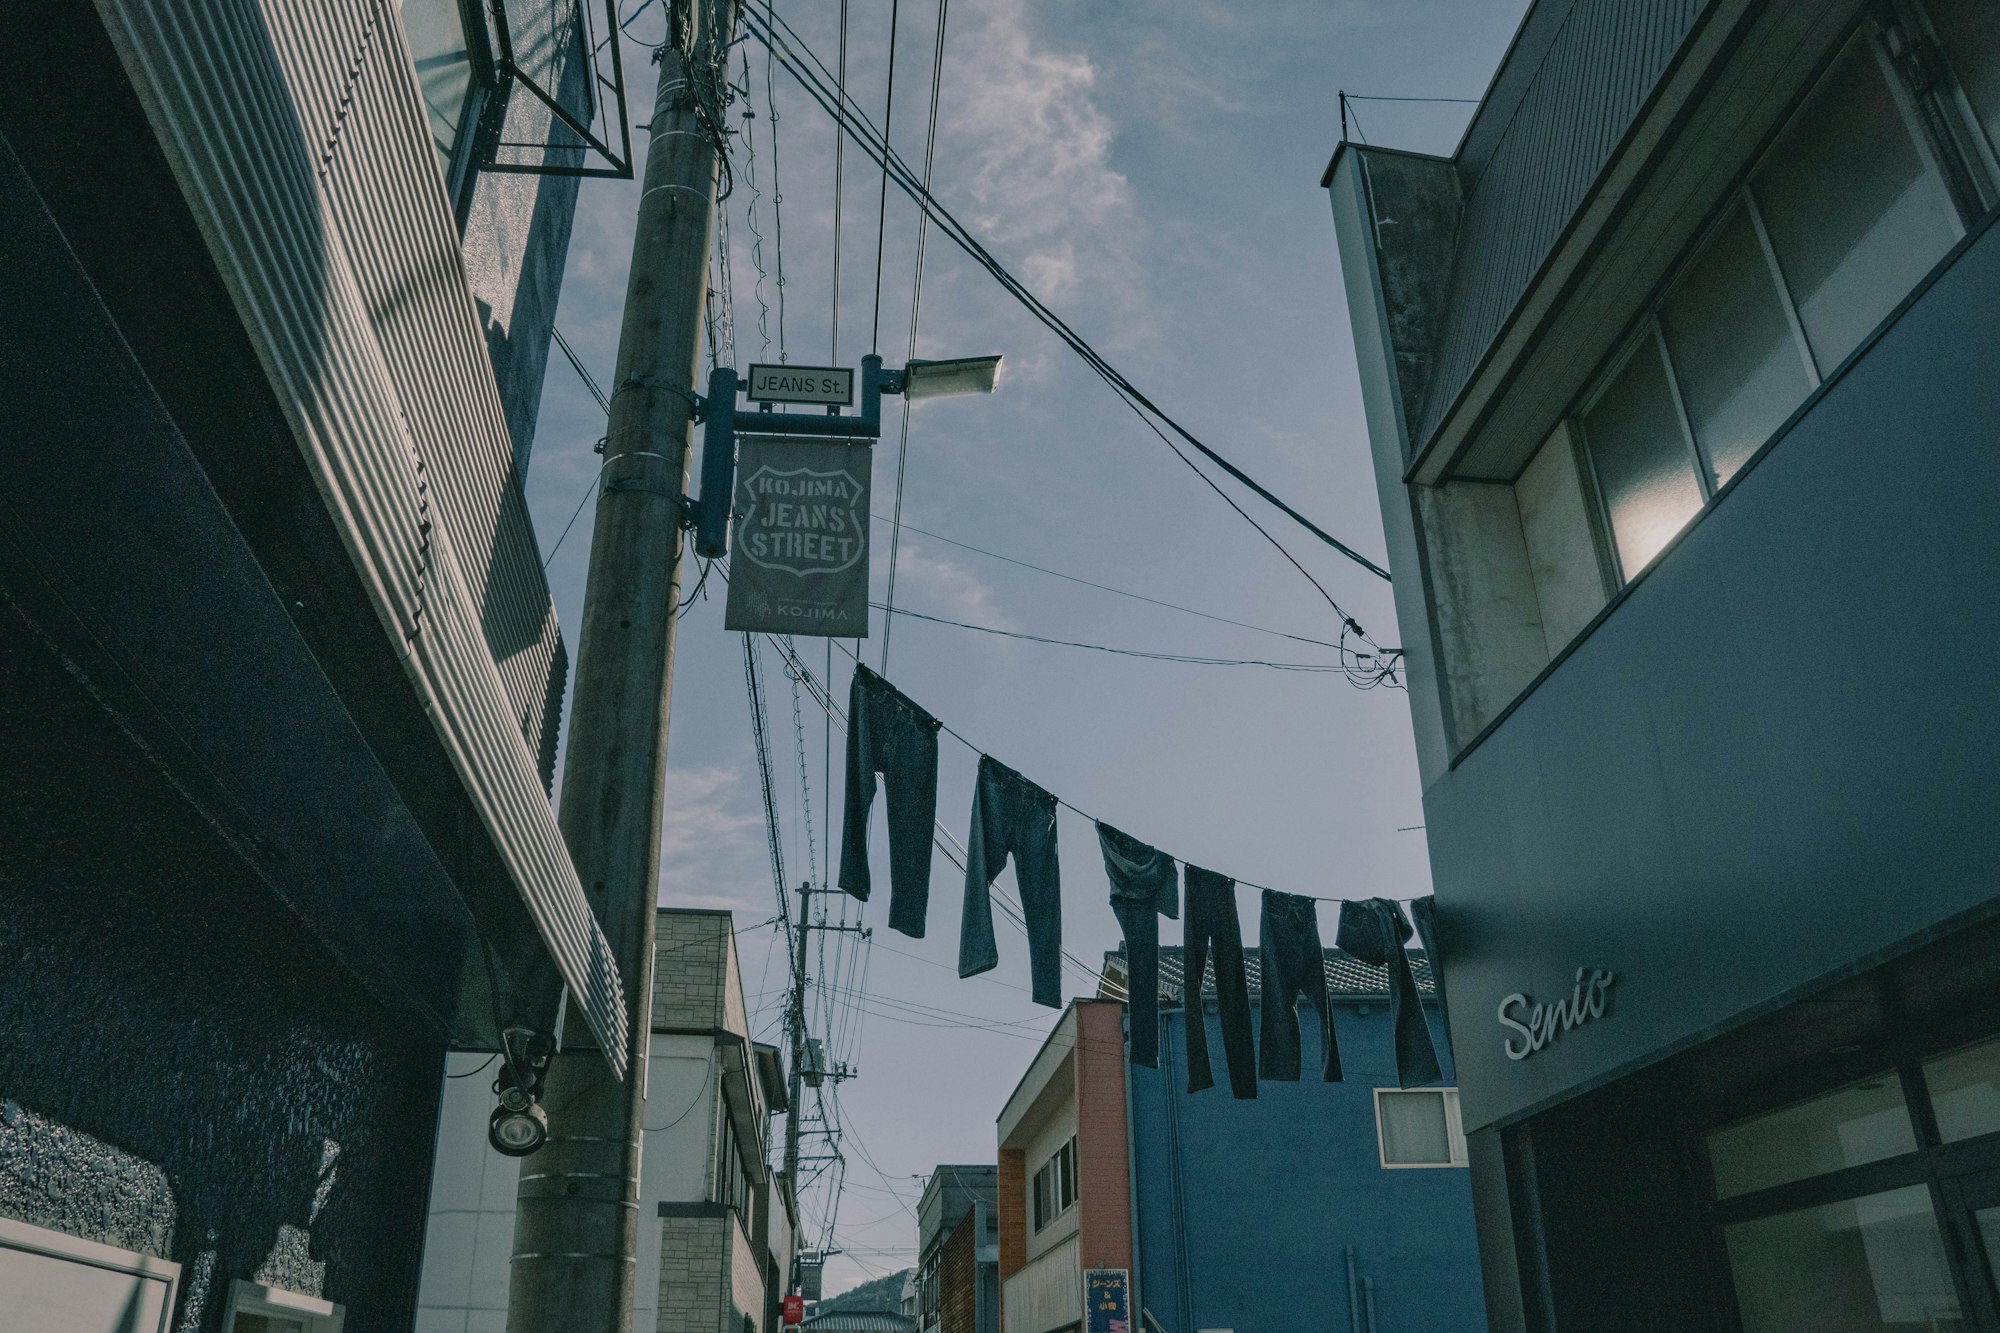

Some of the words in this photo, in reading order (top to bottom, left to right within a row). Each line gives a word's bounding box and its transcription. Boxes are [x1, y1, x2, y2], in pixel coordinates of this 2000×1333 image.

[756, 375, 815, 393] JEANS
[821, 378, 845, 395] St.
[759, 477, 849, 499] KOJIMA
[761, 503, 846, 532] JEANS
[751, 532, 853, 562] STREET
[777, 604, 848, 620] KOJIMA
[1497, 966, 1613, 1060] Senio
